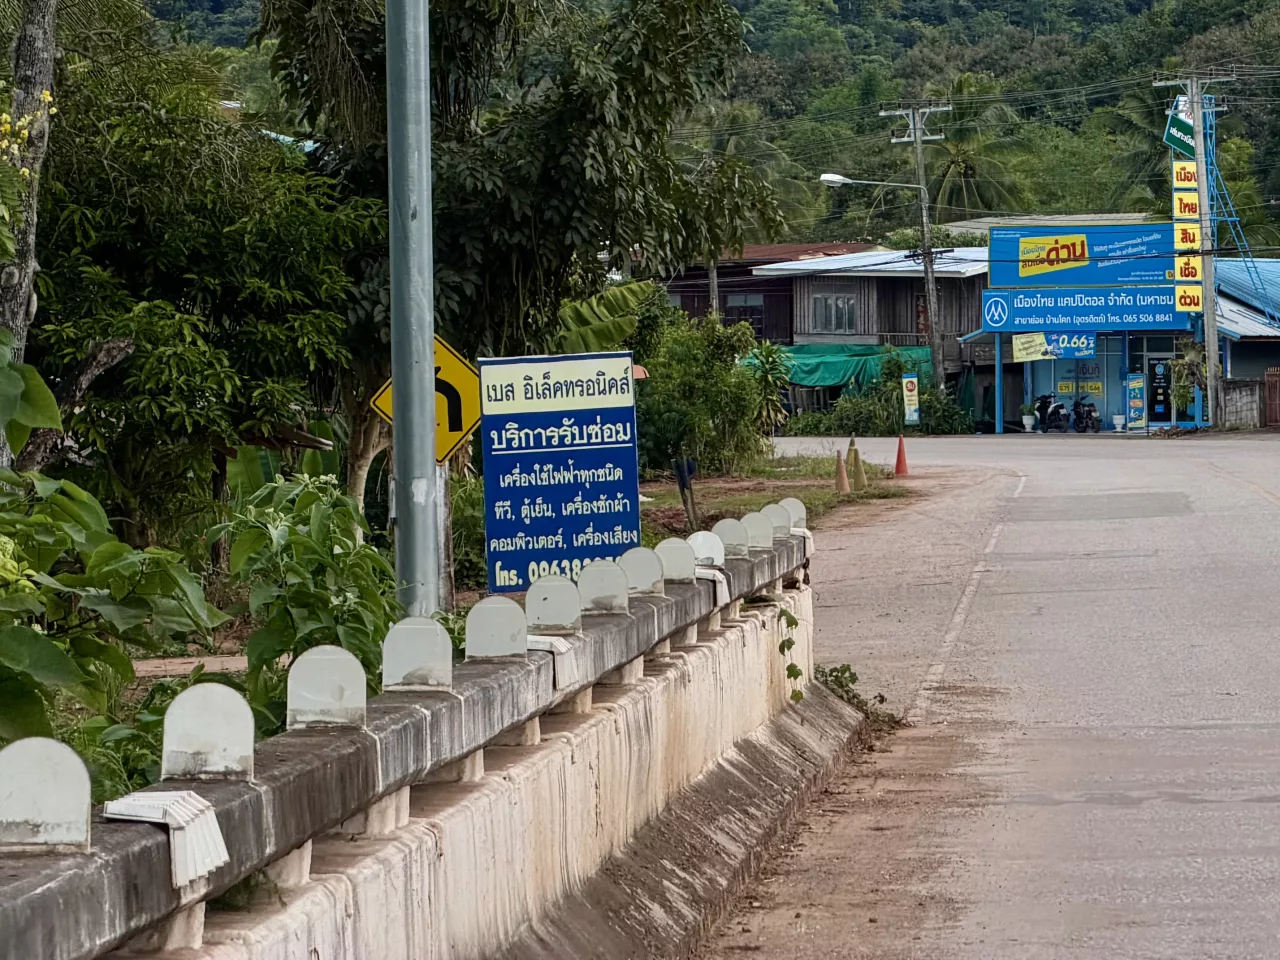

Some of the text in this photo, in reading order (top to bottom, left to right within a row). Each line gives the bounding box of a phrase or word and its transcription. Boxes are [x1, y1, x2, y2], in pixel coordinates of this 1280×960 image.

[1177, 197, 1198, 214] ไทย
[1180, 228, 1196, 244] สิน
[1180, 258, 1198, 278] เชื่อ
[1014, 294, 1055, 308] เมืองไทย
[1057, 293, 1105, 307] แคปปิตอล
[1107, 292, 1133, 306] จำกัด
[1179, 290, 1200, 307] ด่วน
[1123, 314, 1138, 323] 065
[1139, 314, 1154, 322] 506
[1155, 313, 1173, 322] 8841
[486, 366, 631, 403] เบส อิเล็คทรอนิคส์
[490, 415, 631, 450] บริการรับซ่อม
[499, 458, 624, 489] เครื่องใช้ไฟฟ้าทุกชนิด
[573, 522, 638, 547] เครื่องเสียง
[495, 561, 523, 587] โทร.
